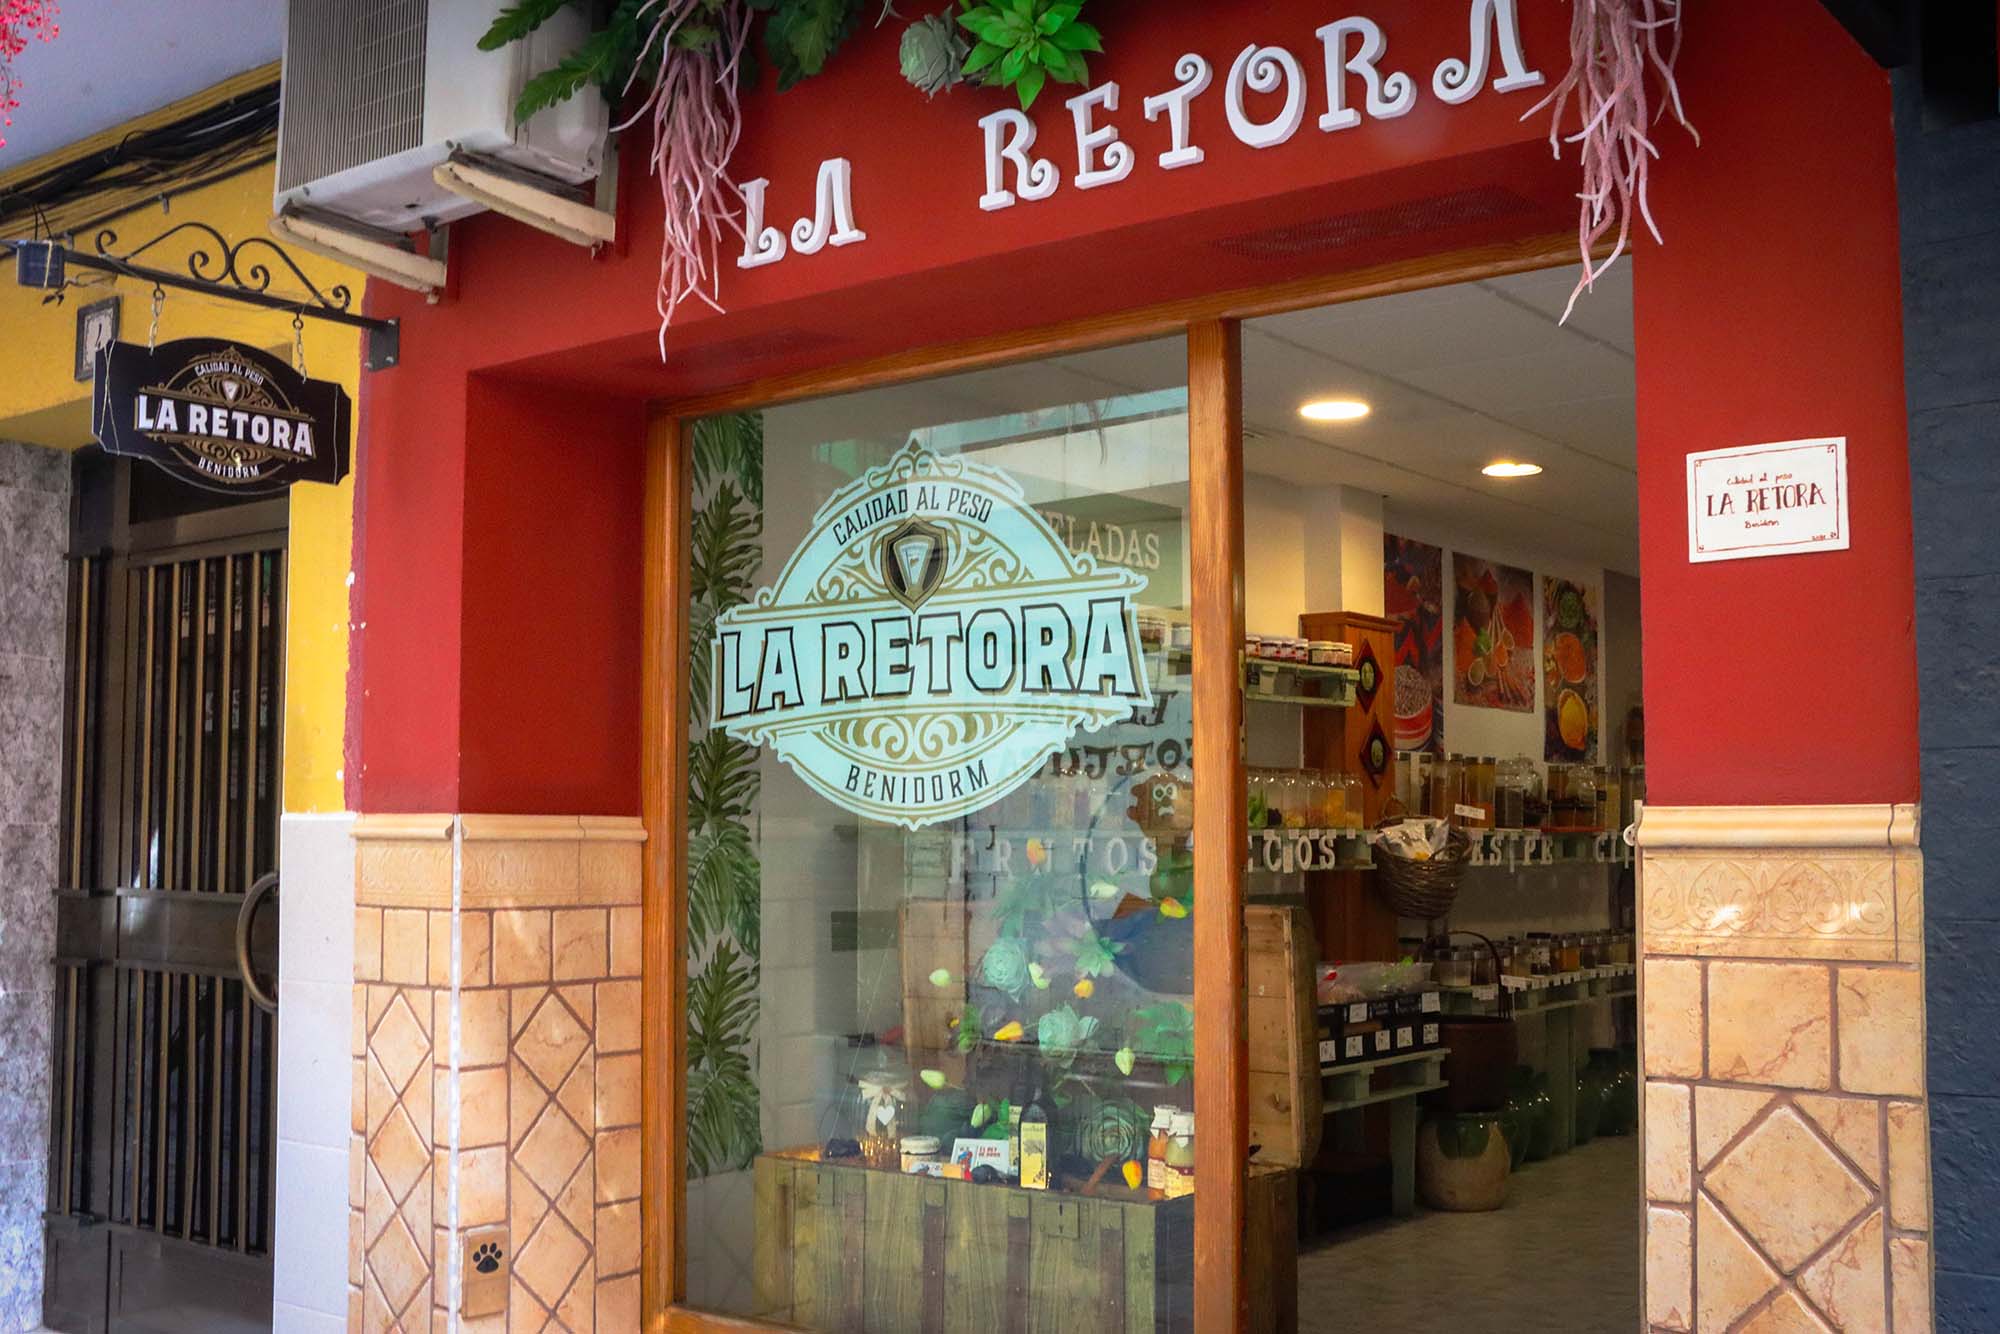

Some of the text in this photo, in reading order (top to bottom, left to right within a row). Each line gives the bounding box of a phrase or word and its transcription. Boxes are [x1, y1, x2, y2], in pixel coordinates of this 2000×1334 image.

[737, 0, 1545, 269] LA RETORA
[194, 361, 264, 386] CALIDAD AL PESO
[137, 394, 313, 456] LA RETORA
[198, 456, 260, 479] BENIDORM
[832, 485, 993, 546] CALIDAD AL PESO
[1706, 482, 1827, 517] LA RETORA
[1037, 508, 1160, 570] ELADAS
[720, 596, 1140, 720] LA RETORA
[844, 758, 990, 805] BENIDORM
